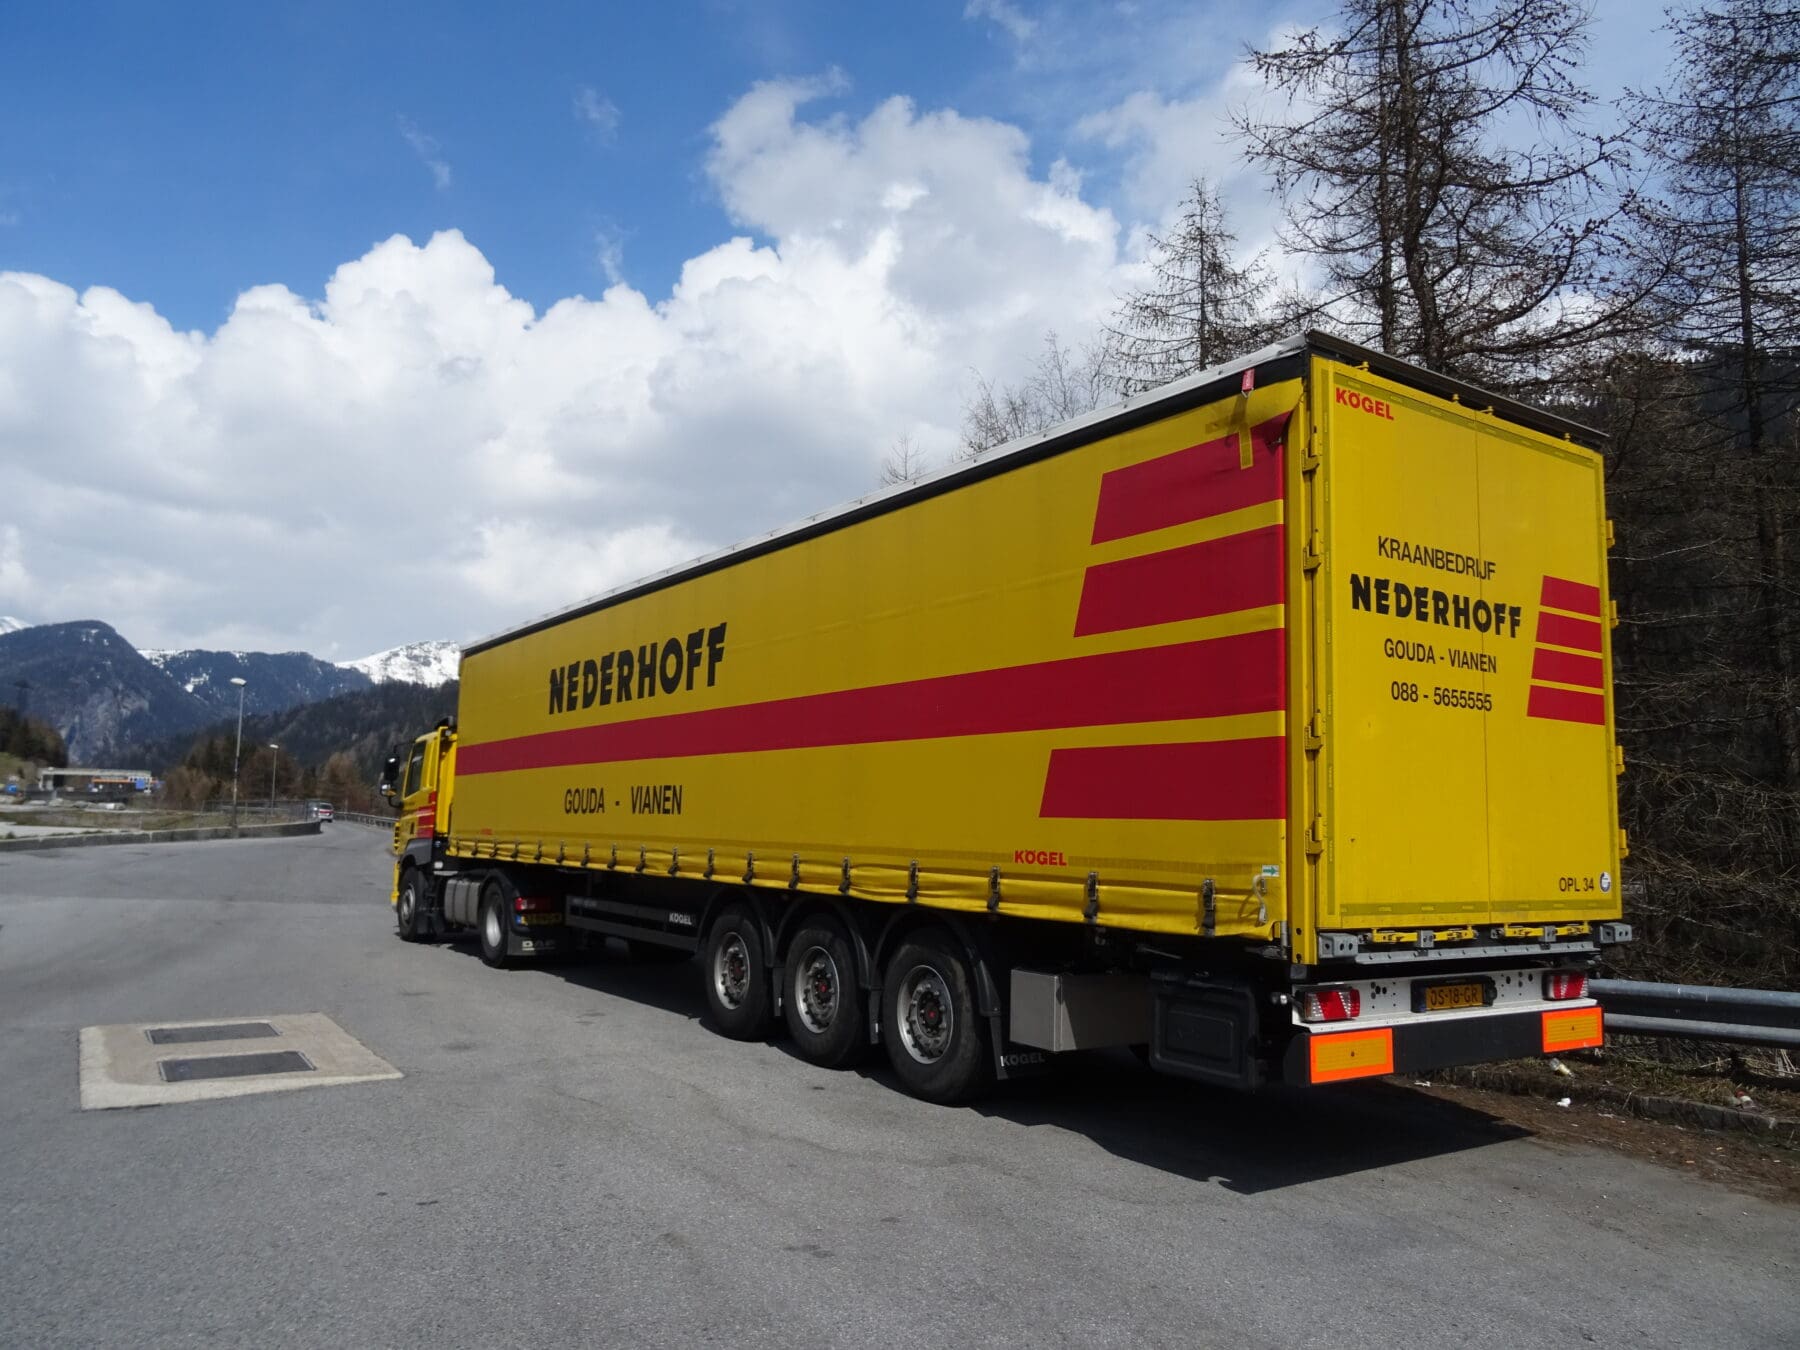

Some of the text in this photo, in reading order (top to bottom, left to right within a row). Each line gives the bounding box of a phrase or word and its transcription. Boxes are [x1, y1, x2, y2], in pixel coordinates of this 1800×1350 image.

[1335, 387, 1394, 421] KÖGEL
[1377, 535, 1497, 580] KRAANBEDRIJF
[1349, 573, 1522, 639] NEDERHOFF
[548, 622, 728, 715] NEDERHOFF
[1383, 638, 1436, 664] GOUDA
[1448, 648, 1497, 673] VIANEN
[1391, 680, 1419, 703] 088
[1433, 686, 1493, 712] 5655555
[564, 787, 605, 815] GOUDA
[631, 784, 683, 815] VIANEN
[1559, 877, 1581, 892] OPL
[1583, 877, 1595, 892] 34
